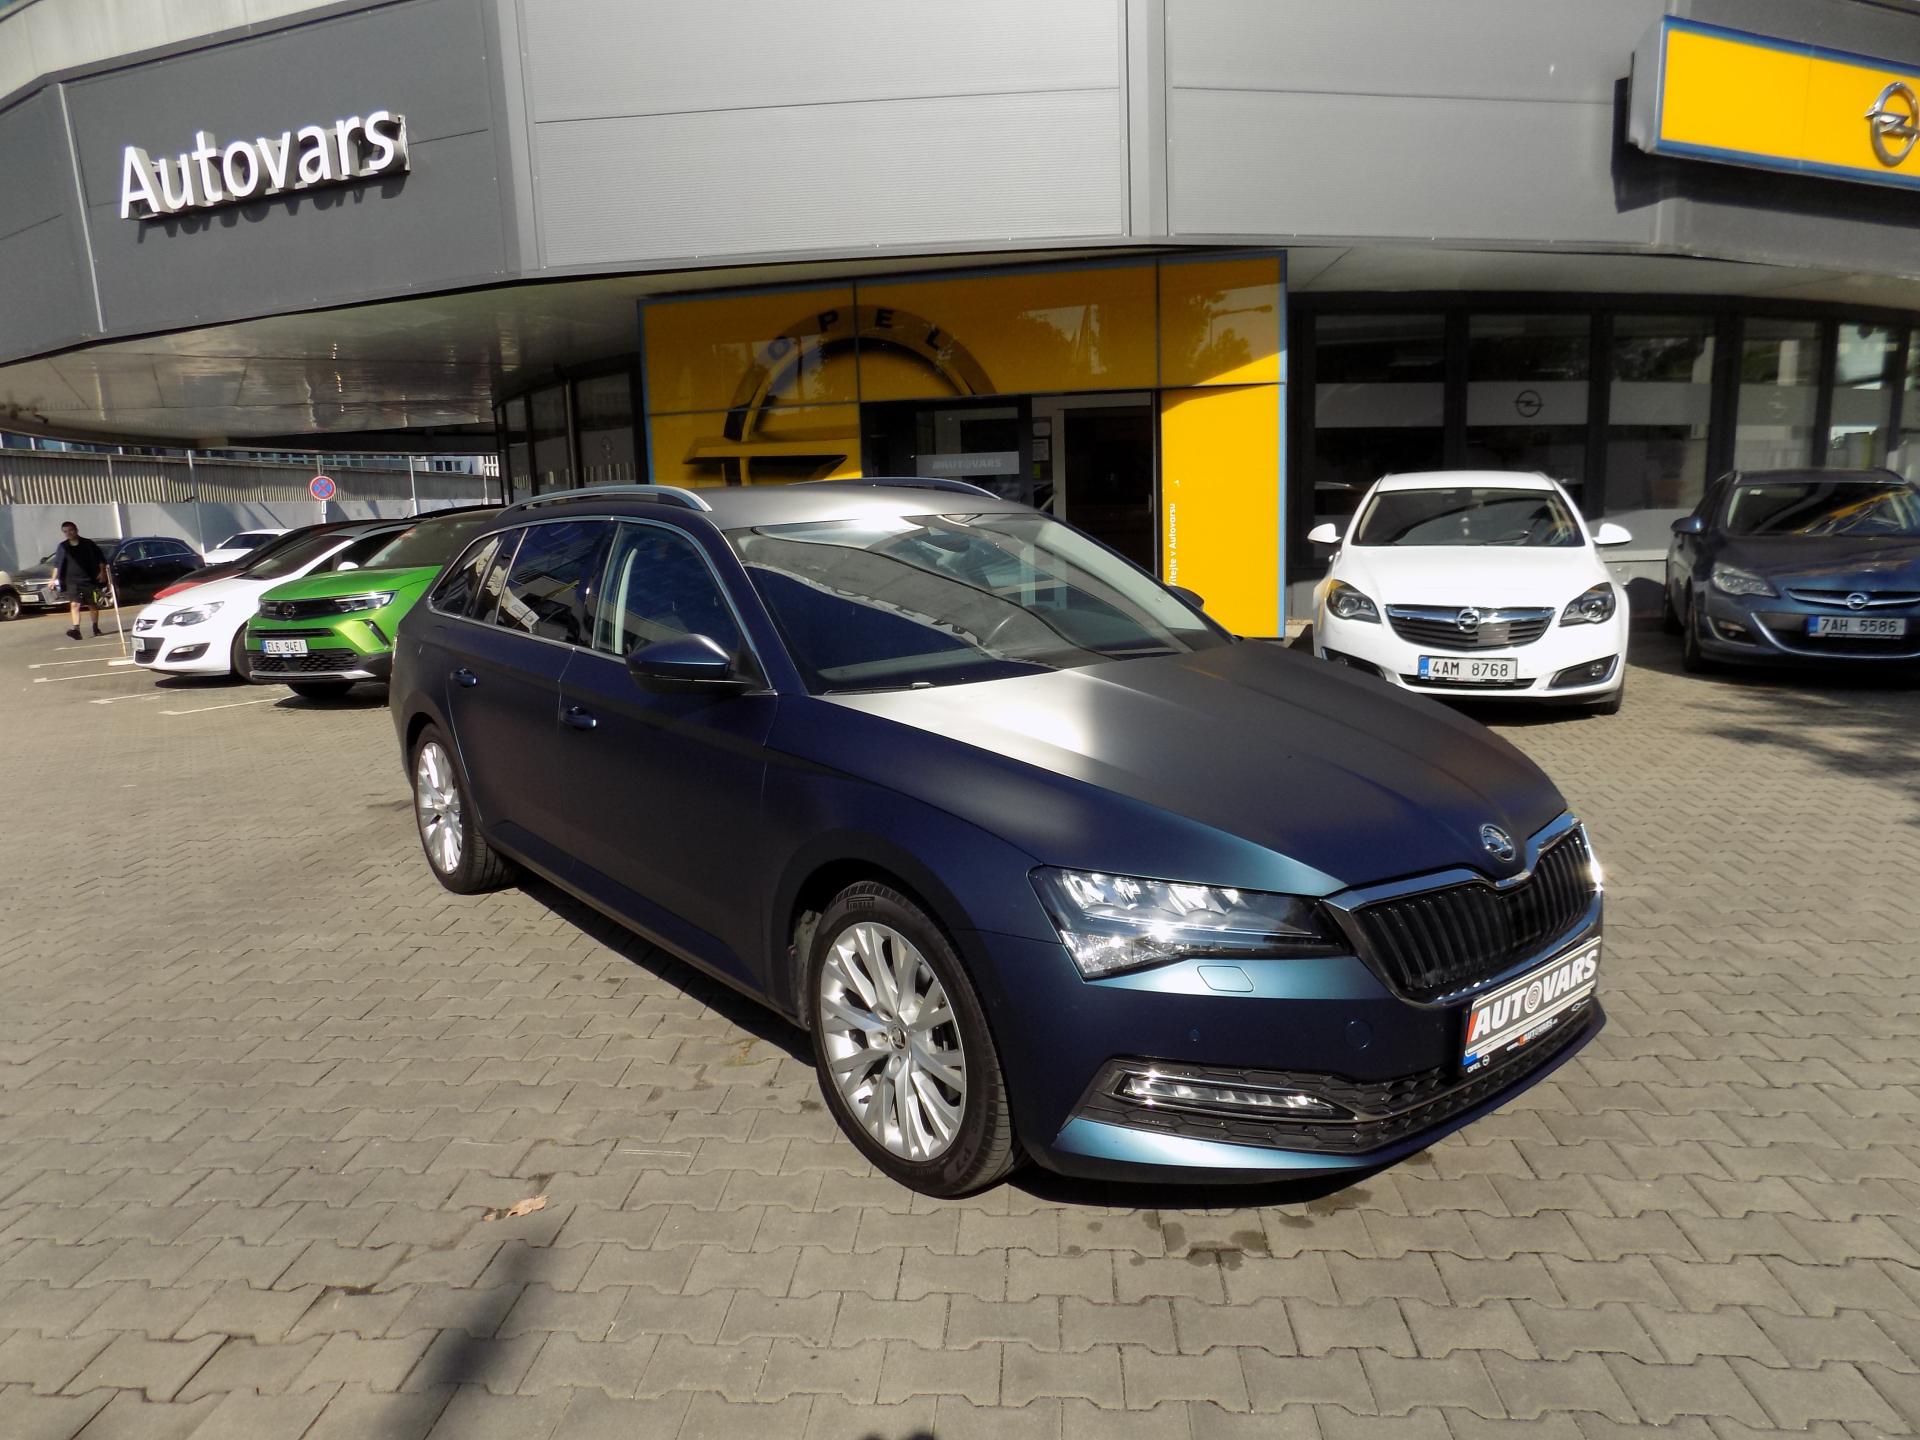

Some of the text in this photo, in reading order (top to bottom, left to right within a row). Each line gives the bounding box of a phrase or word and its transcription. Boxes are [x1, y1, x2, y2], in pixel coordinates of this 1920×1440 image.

[121, 111, 397, 219] Autovars
[767, 308, 944, 361] OPEL
[1168, 504, 1177, 549] Autovarsu
[1822, 619, 1848, 632] 7AH
[1860, 620, 1897, 633] 5586
[1432, 661, 1509, 677] 4AM 8768
[1470, 949, 1598, 1042] AUTOVARS
